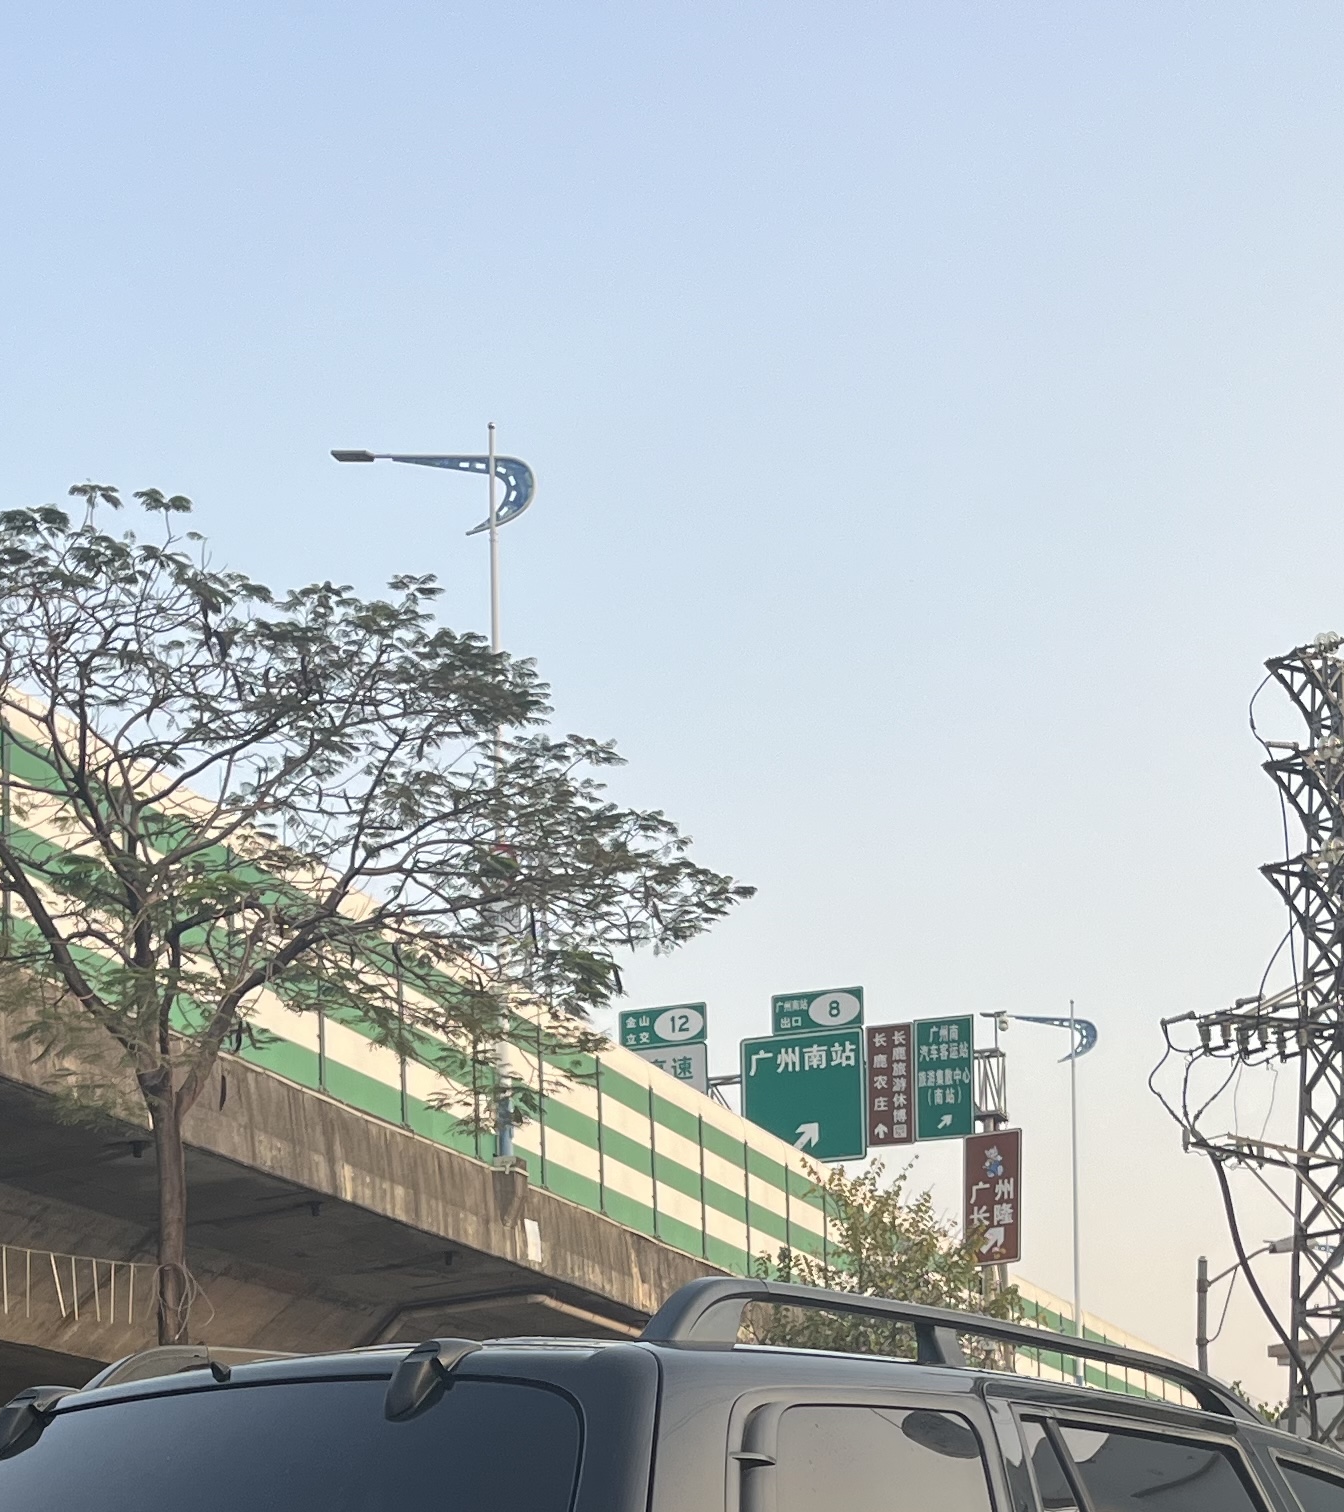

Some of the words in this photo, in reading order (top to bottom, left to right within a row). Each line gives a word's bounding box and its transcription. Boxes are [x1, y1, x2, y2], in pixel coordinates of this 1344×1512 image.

[829, 1000, 840, 1017] 8
[625, 1015, 650, 1028] 金山
[670, 1015, 689, 1033] 12
[780, 1017, 801, 1028] 出口
[626, 1032, 650, 1045] 立交
[929, 1024, 959, 1043] 广州南
[749, 1041, 856, 1076] 广州南站
[919, 1041, 969, 1062] 汽车客运站
[873, 1032, 888, 1111] 长鹿农庄
[970, 1177, 1014, 1204] 广州
[969, 1203, 1014, 1227] 长隆
